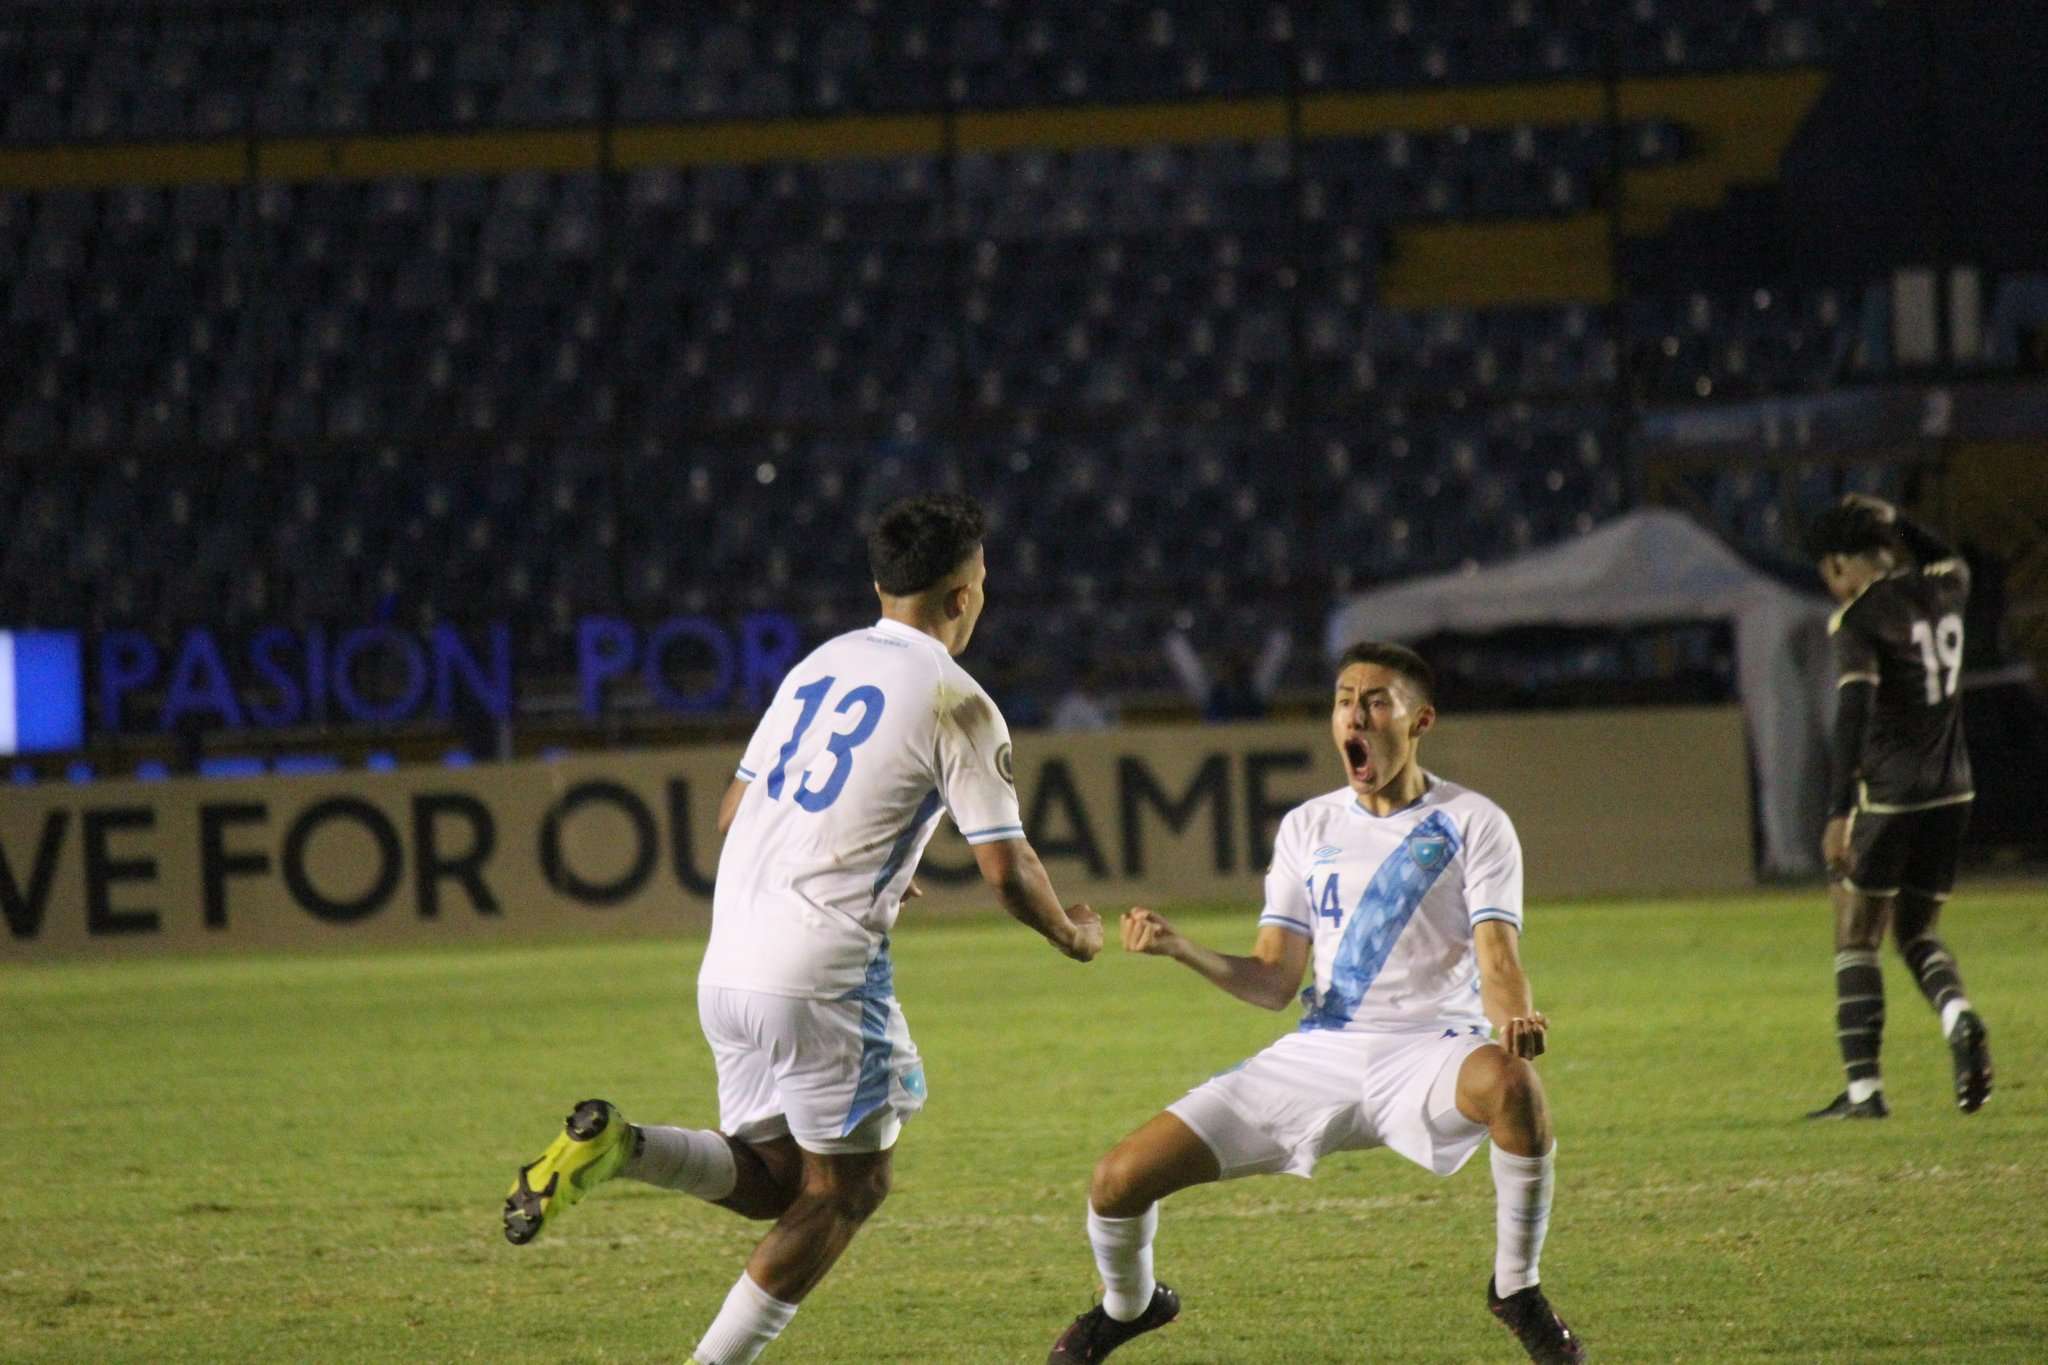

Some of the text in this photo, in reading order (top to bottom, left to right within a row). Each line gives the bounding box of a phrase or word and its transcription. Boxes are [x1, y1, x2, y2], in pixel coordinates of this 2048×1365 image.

[100, 595, 800, 732] PASIÓN POR
[1910, 614, 1965, 704] 19
[767, 675, 885, 813] 13
[204, 795, 501, 930] FOR
[538, 778, 719, 905] OU
[914, 749, 1313, 886] AME
[1305, 872, 1344, 929] 14
